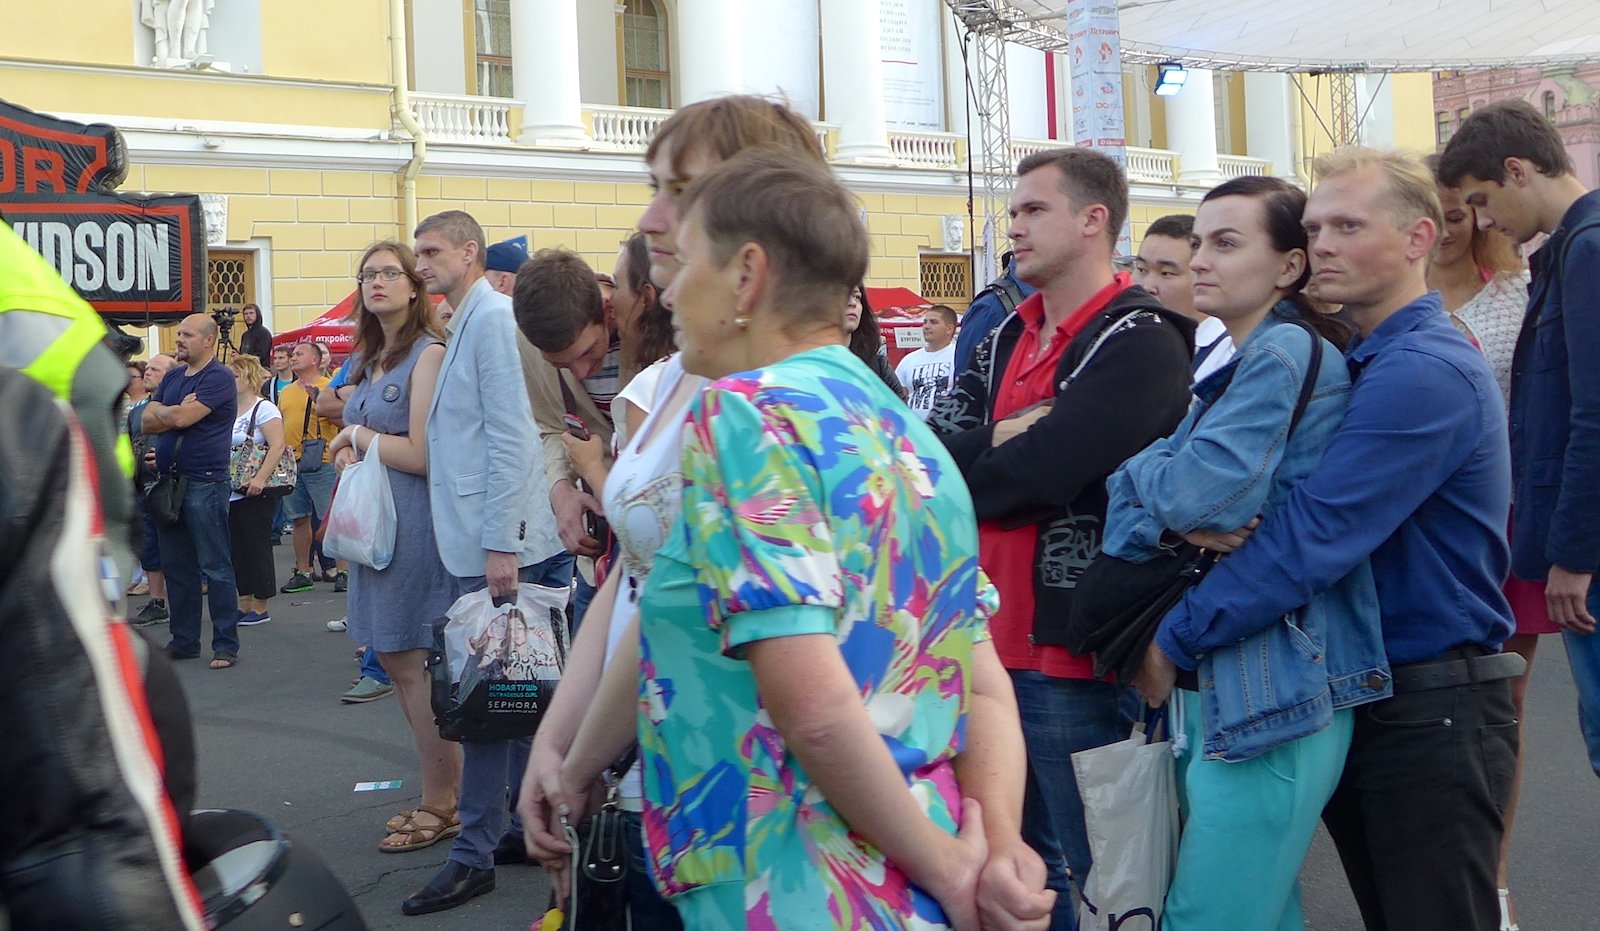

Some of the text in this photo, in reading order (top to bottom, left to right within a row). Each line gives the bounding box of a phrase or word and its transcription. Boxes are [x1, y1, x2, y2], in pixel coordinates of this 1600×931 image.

[13, 221, 170, 292] DSON
[913, 361, 951, 379] THIS
[488, 701, 538, 709] SEPHORA
